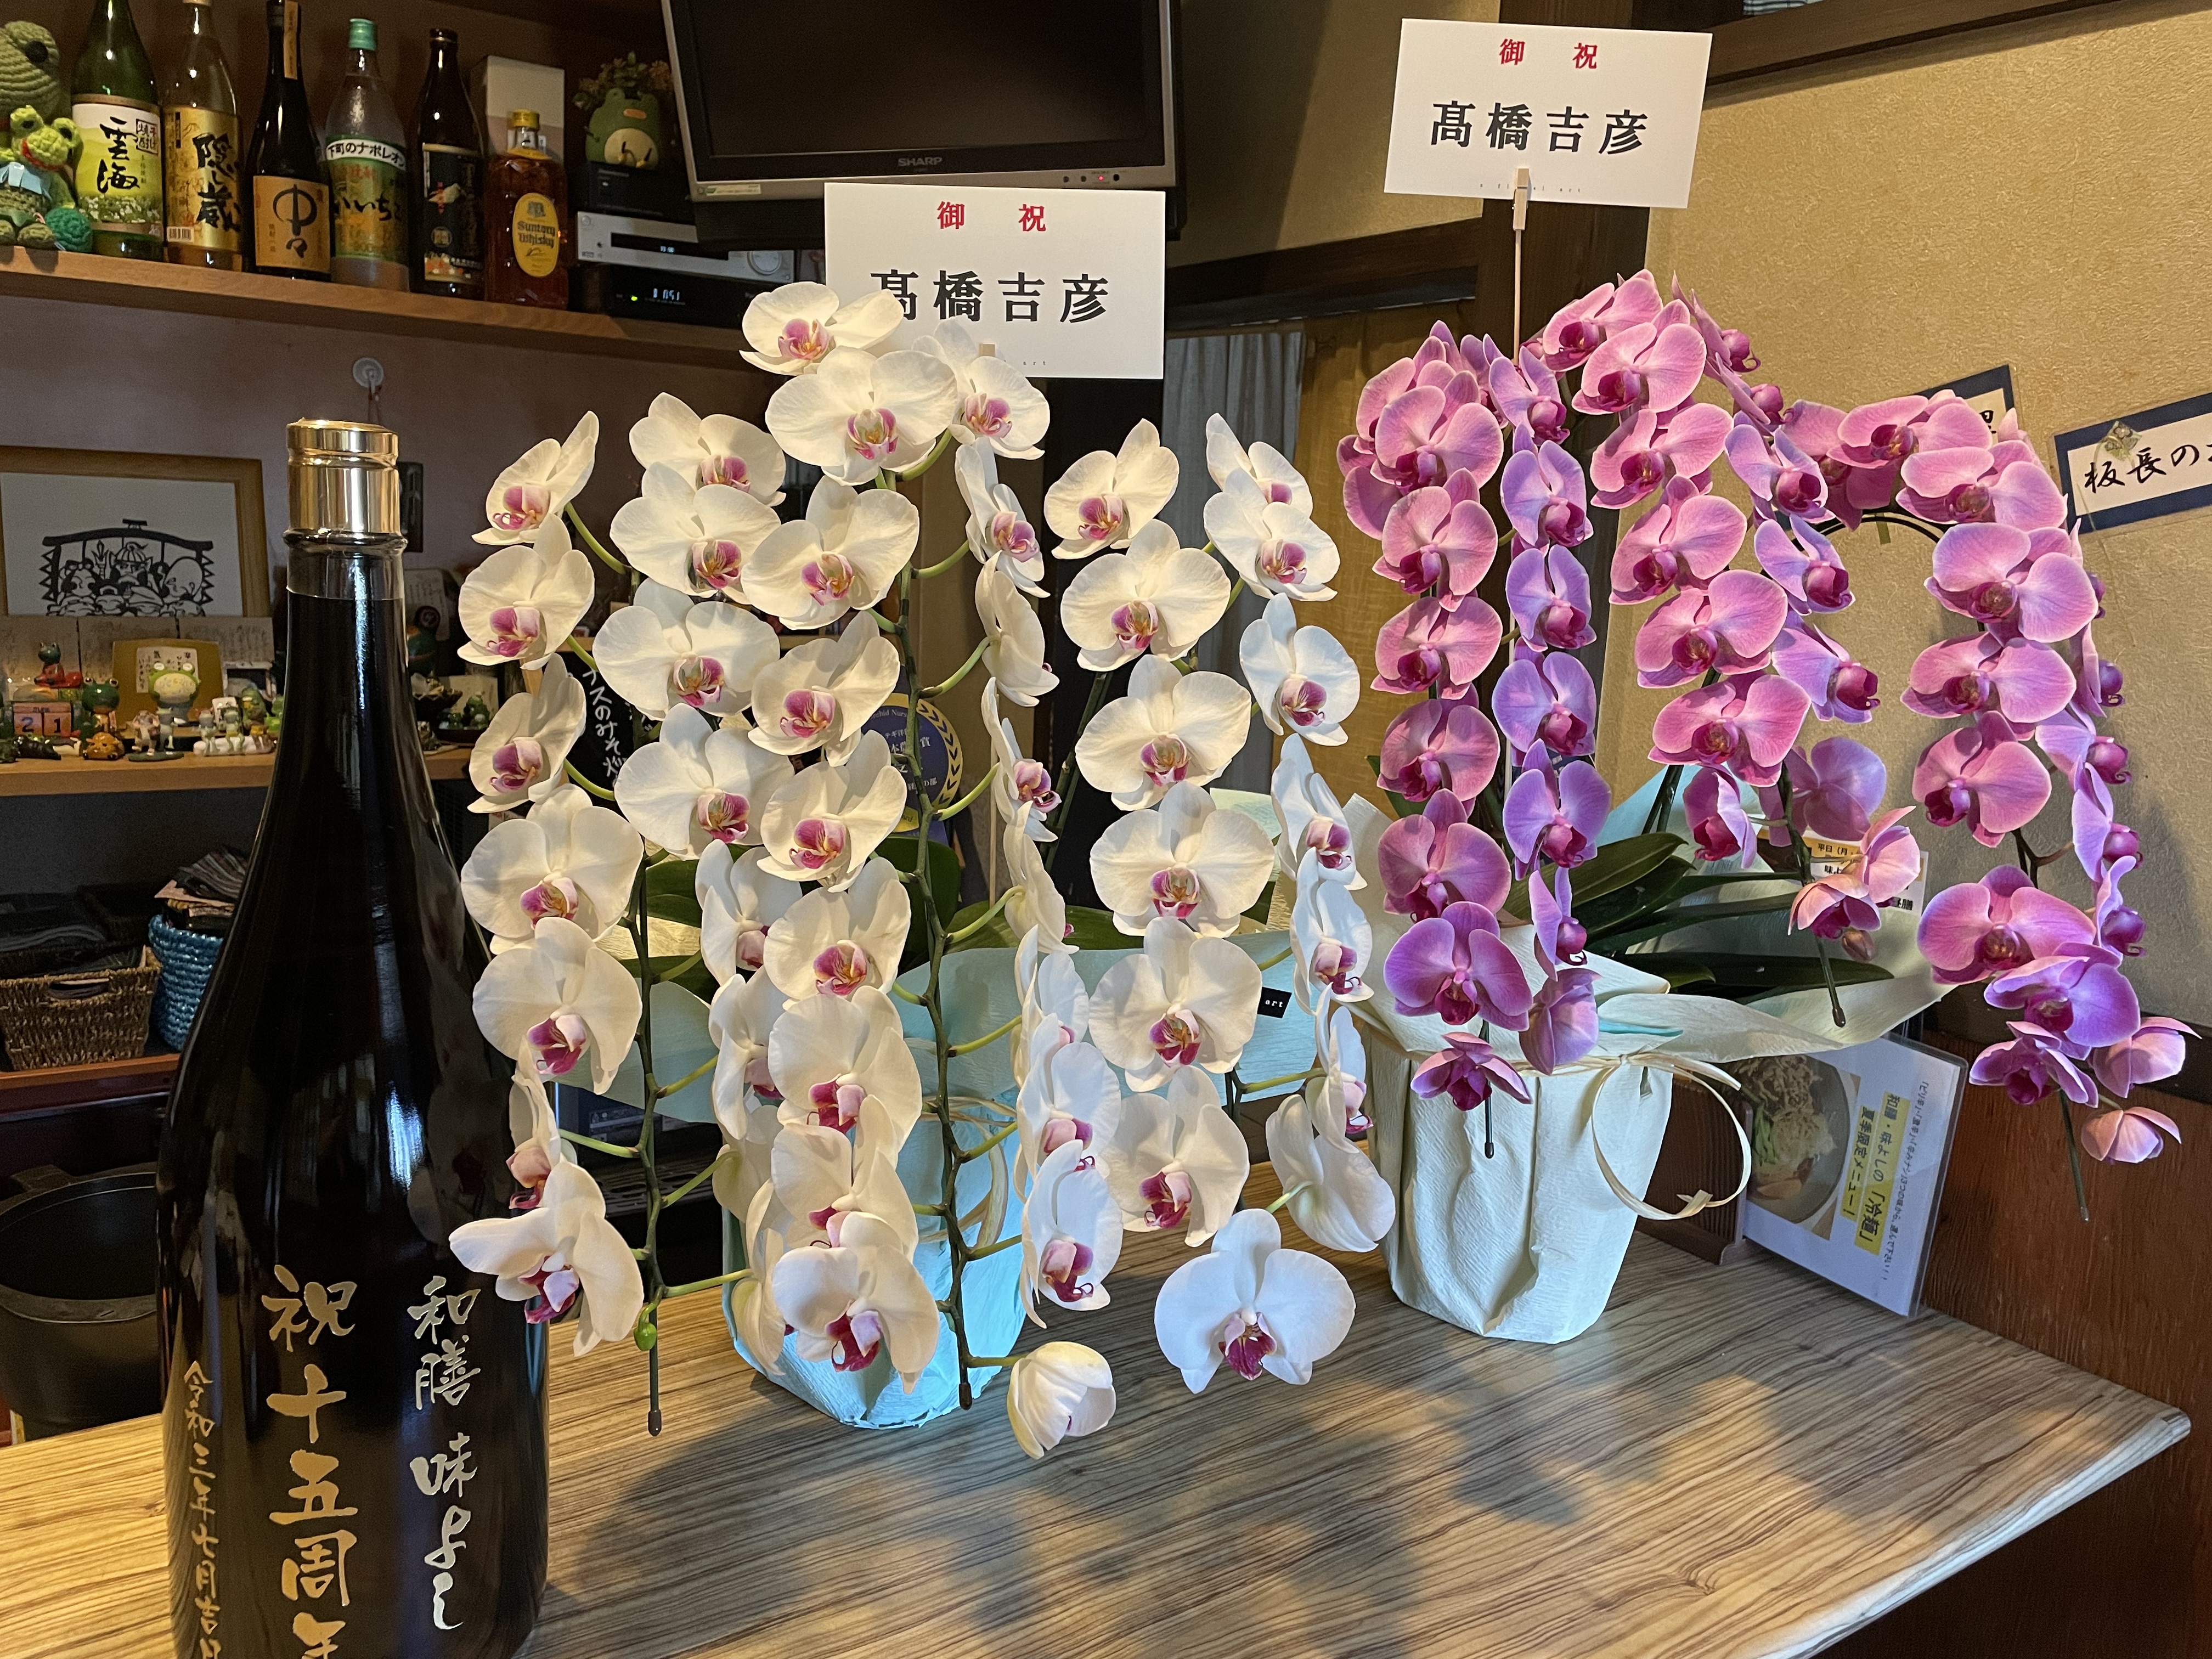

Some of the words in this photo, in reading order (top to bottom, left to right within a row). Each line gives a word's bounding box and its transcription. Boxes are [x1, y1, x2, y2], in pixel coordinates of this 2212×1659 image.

[97, 116, 140, 194] 雲海
[898, 157, 943, 167] SHARP
[273, 184, 317, 258] 中々
[517, 220, 555, 237] Suntory
[517, 231, 554, 249] Whisky
[2084, 444, 2212, 494] 板長の
[582, 668, 628, 788] ナスのみそ炒
[871, 708, 889, 719] rchid
[891, 709, 907, 717] Nurs
[409, 1432, 478, 1630] 味よし
